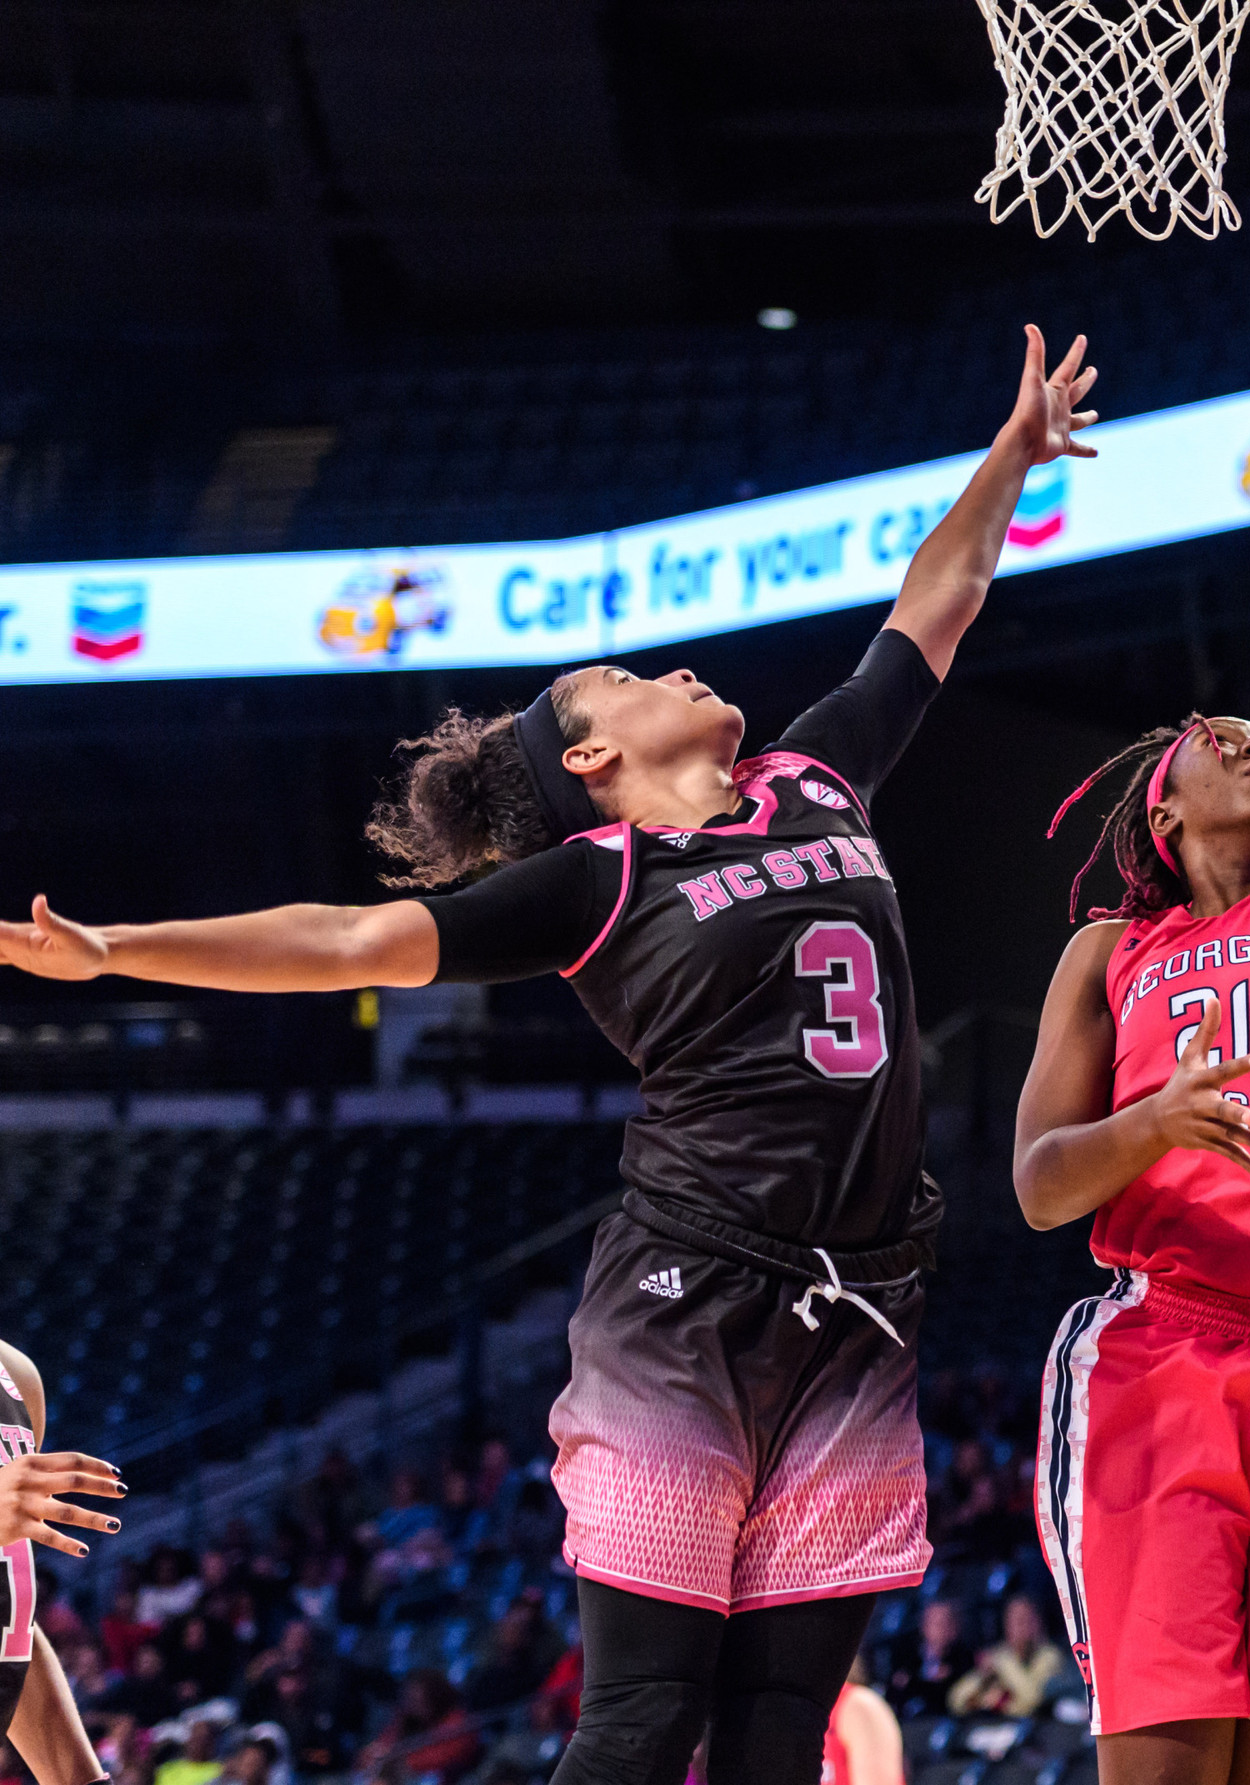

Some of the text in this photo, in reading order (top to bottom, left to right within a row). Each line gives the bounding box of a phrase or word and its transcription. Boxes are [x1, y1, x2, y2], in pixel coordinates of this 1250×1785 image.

[497, 498, 955, 634] Care for your ca
[677, 836, 896, 922] NC STAT
[795, 921, 889, 1079] 3
[1169, 978, 1250, 1071] 21
[639, 1279, 684, 1299] adidas
